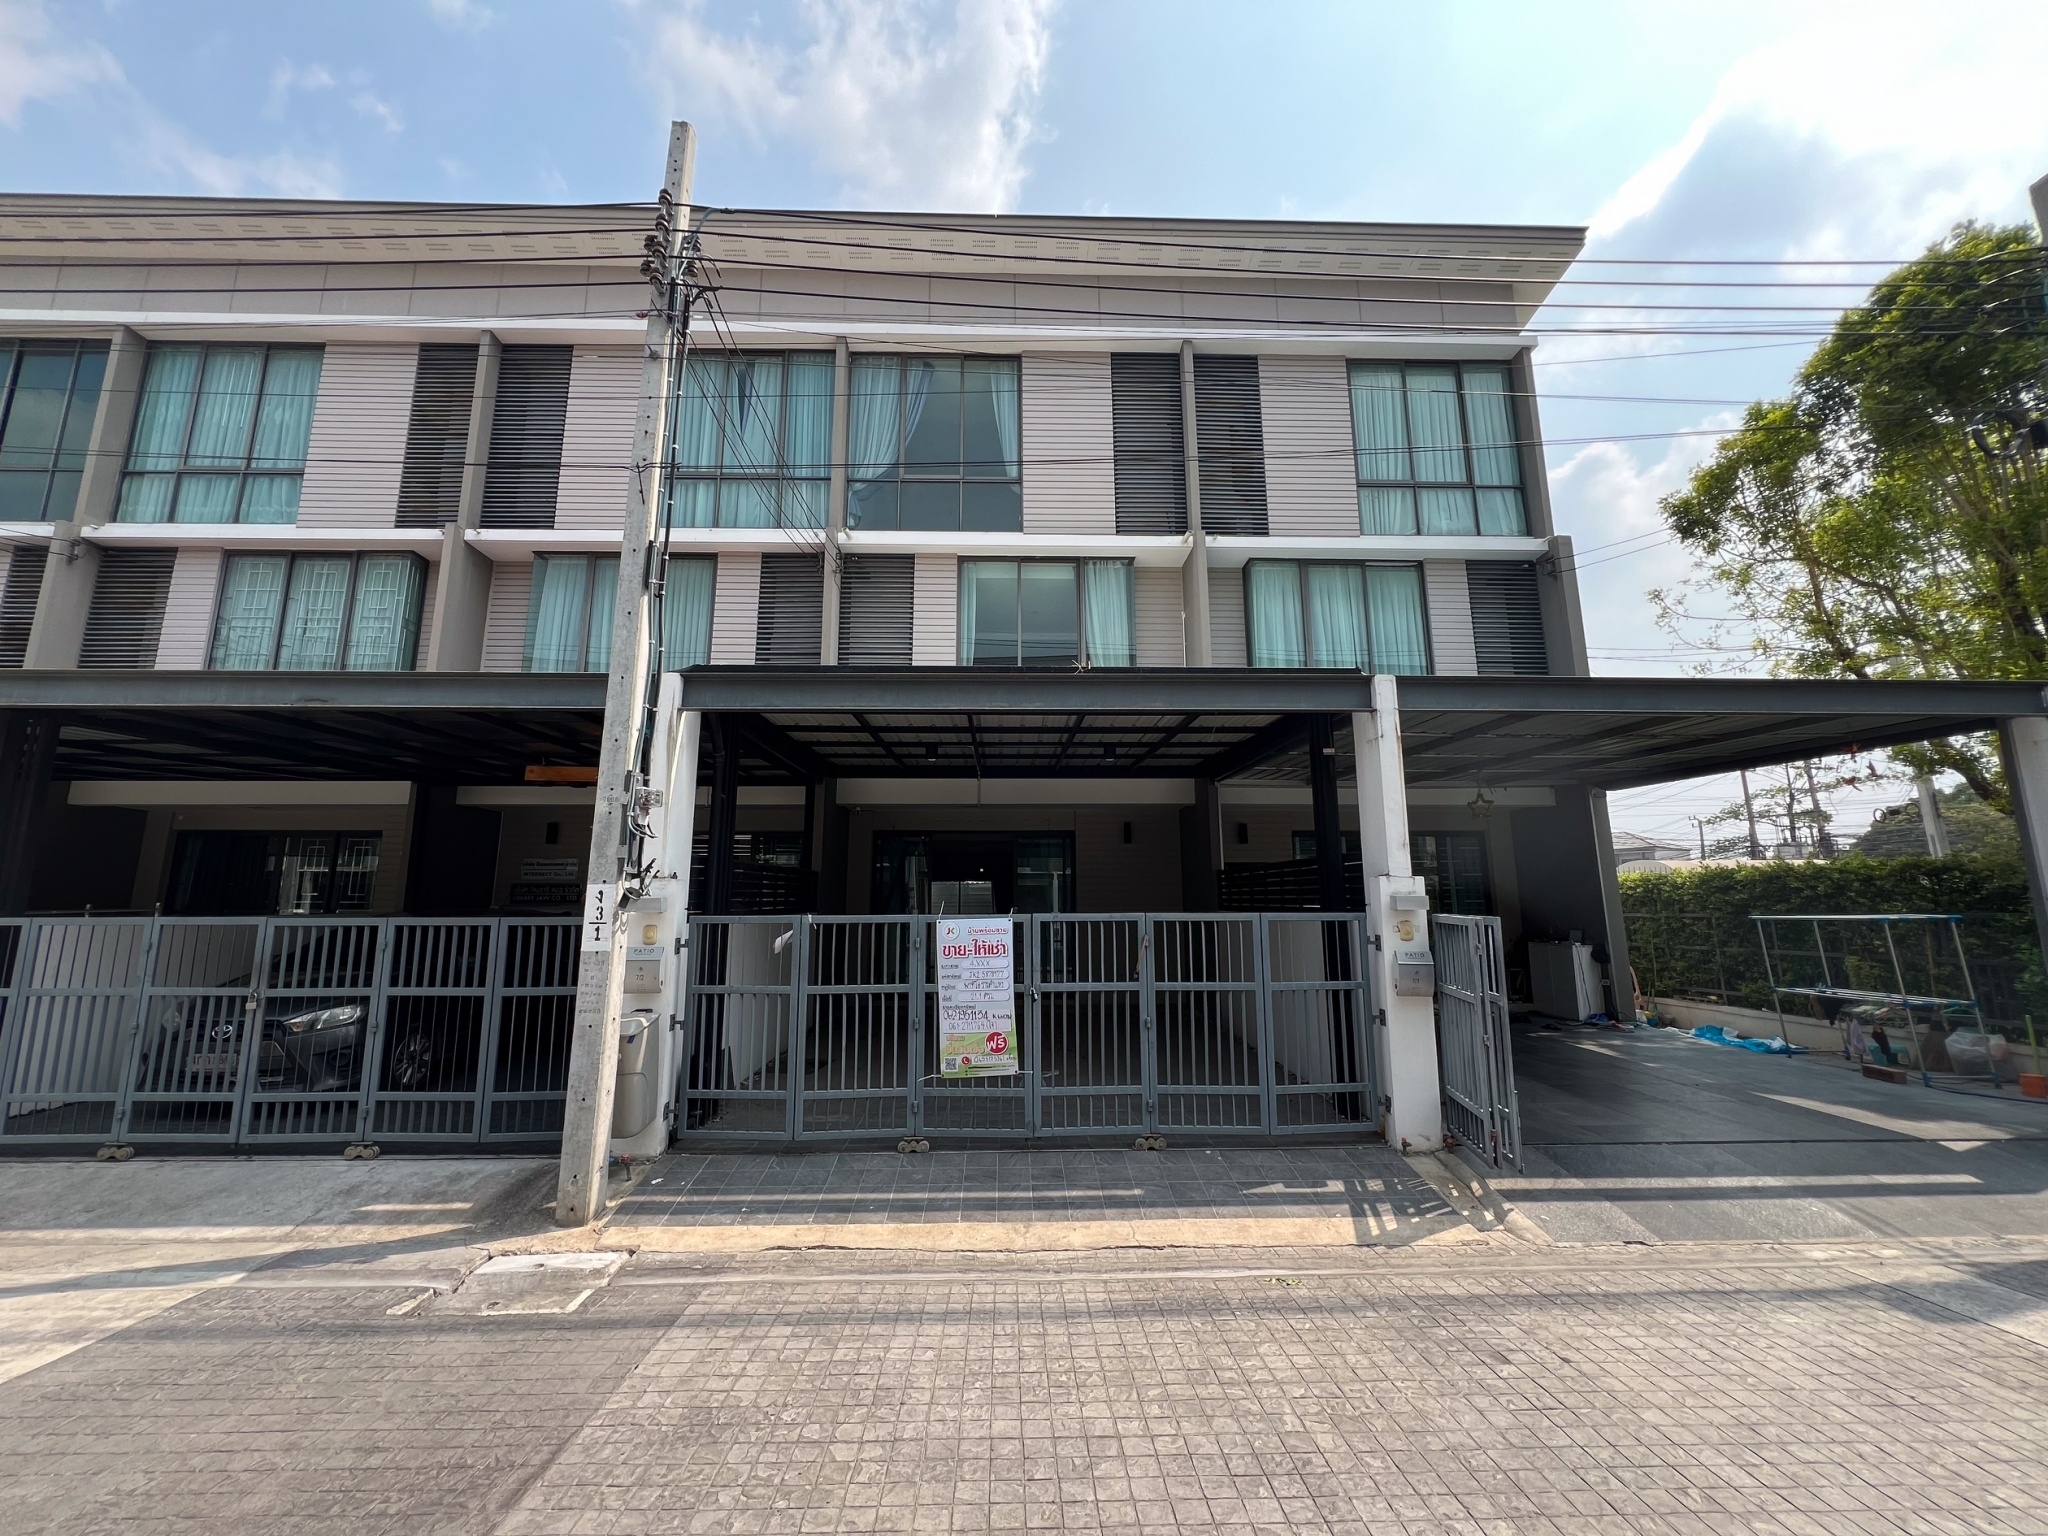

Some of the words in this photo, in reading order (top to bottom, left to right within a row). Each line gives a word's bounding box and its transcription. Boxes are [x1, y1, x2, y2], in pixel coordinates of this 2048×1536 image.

[942, 938, 1007, 957] ขาย-ให้เช่า
[986, 1034, 1006, 1051] ฟรี
